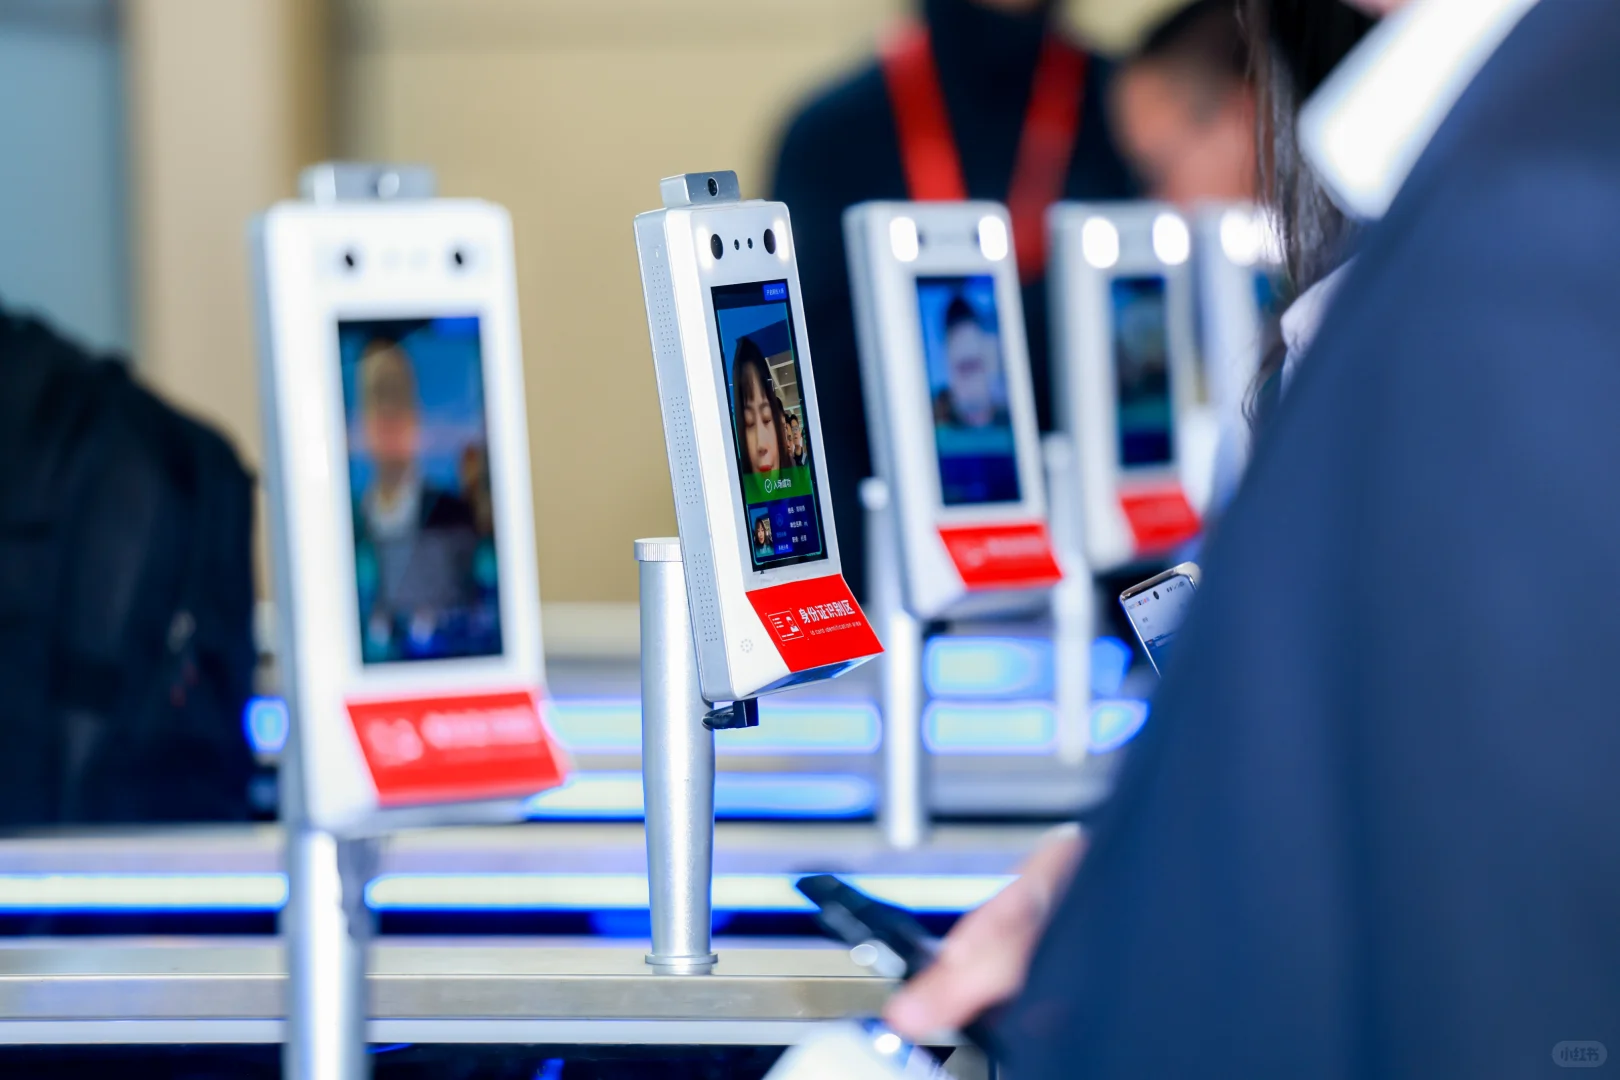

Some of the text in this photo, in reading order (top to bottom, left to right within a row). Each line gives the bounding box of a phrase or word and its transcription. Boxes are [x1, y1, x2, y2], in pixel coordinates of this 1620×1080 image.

[798, 599, 855, 624] 身份证识别区
[825, 622, 852, 633] identification
[851, 620, 862, 628] area
